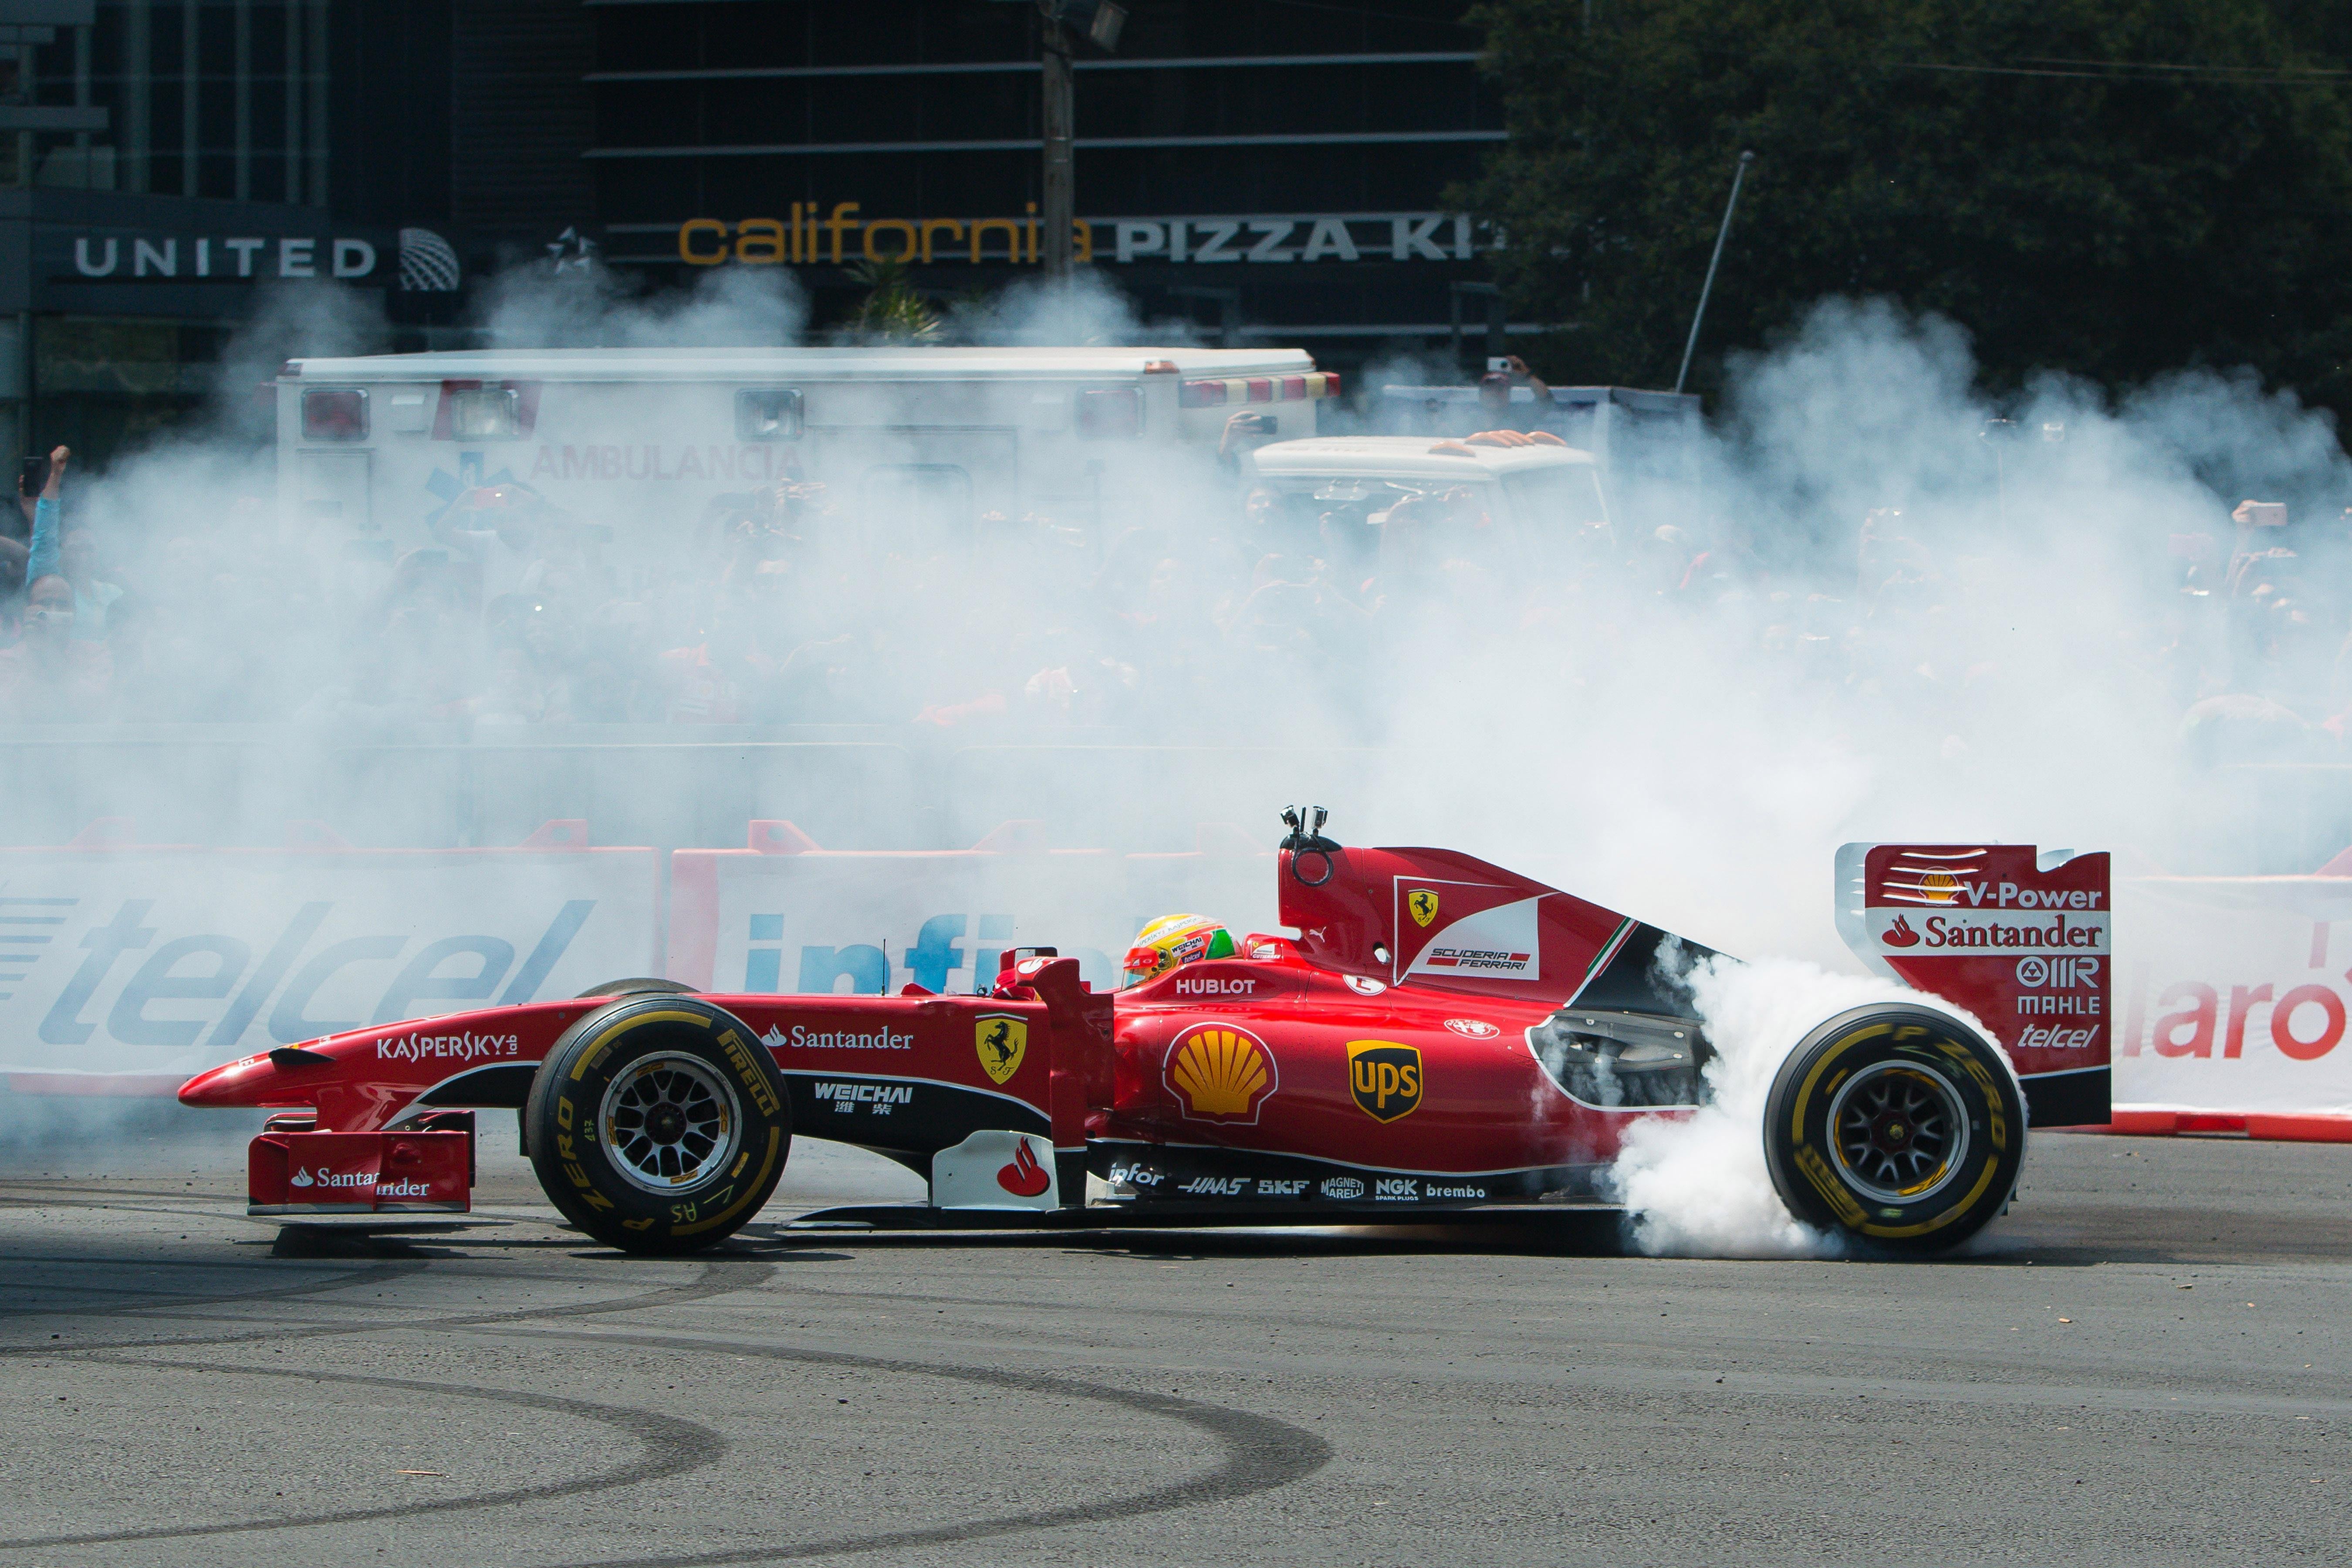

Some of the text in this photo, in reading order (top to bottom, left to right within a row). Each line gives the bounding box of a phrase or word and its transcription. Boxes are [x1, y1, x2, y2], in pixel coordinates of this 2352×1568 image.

[1116, 216, 1359, 262] PIZZA
[75, 237, 376, 277] UNITED
[531, 444, 804, 481] AMBULANCIA
[1964, 882, 2102, 909] V-Power
[1926, 914, 2102, 948] Santander
[1431, 948, 1509, 960] SCUDERIA
[1459, 959, 1526, 970] FERRARI
[38, 898, 597, 1046] telcel
[1176, 979, 1255, 994] HUBLOT
[2017, 996, 2100, 1015] MAHLE
[377, 1031, 517, 1063] KASPERSKY lab
[791, 1026, 913, 1049] Santander
[2017, 1024, 2100, 1048] telcel
[716, 1028, 781, 1118] PIRELLI
[1354, 1060, 1418, 1109] ups
[814, 1082, 913, 1103] WEICHAI
[1108, 1162, 1165, 1186] infor
[1257, 1180, 1310, 1194] SKF
[1375, 1179, 1486, 1198] NGK brembo
